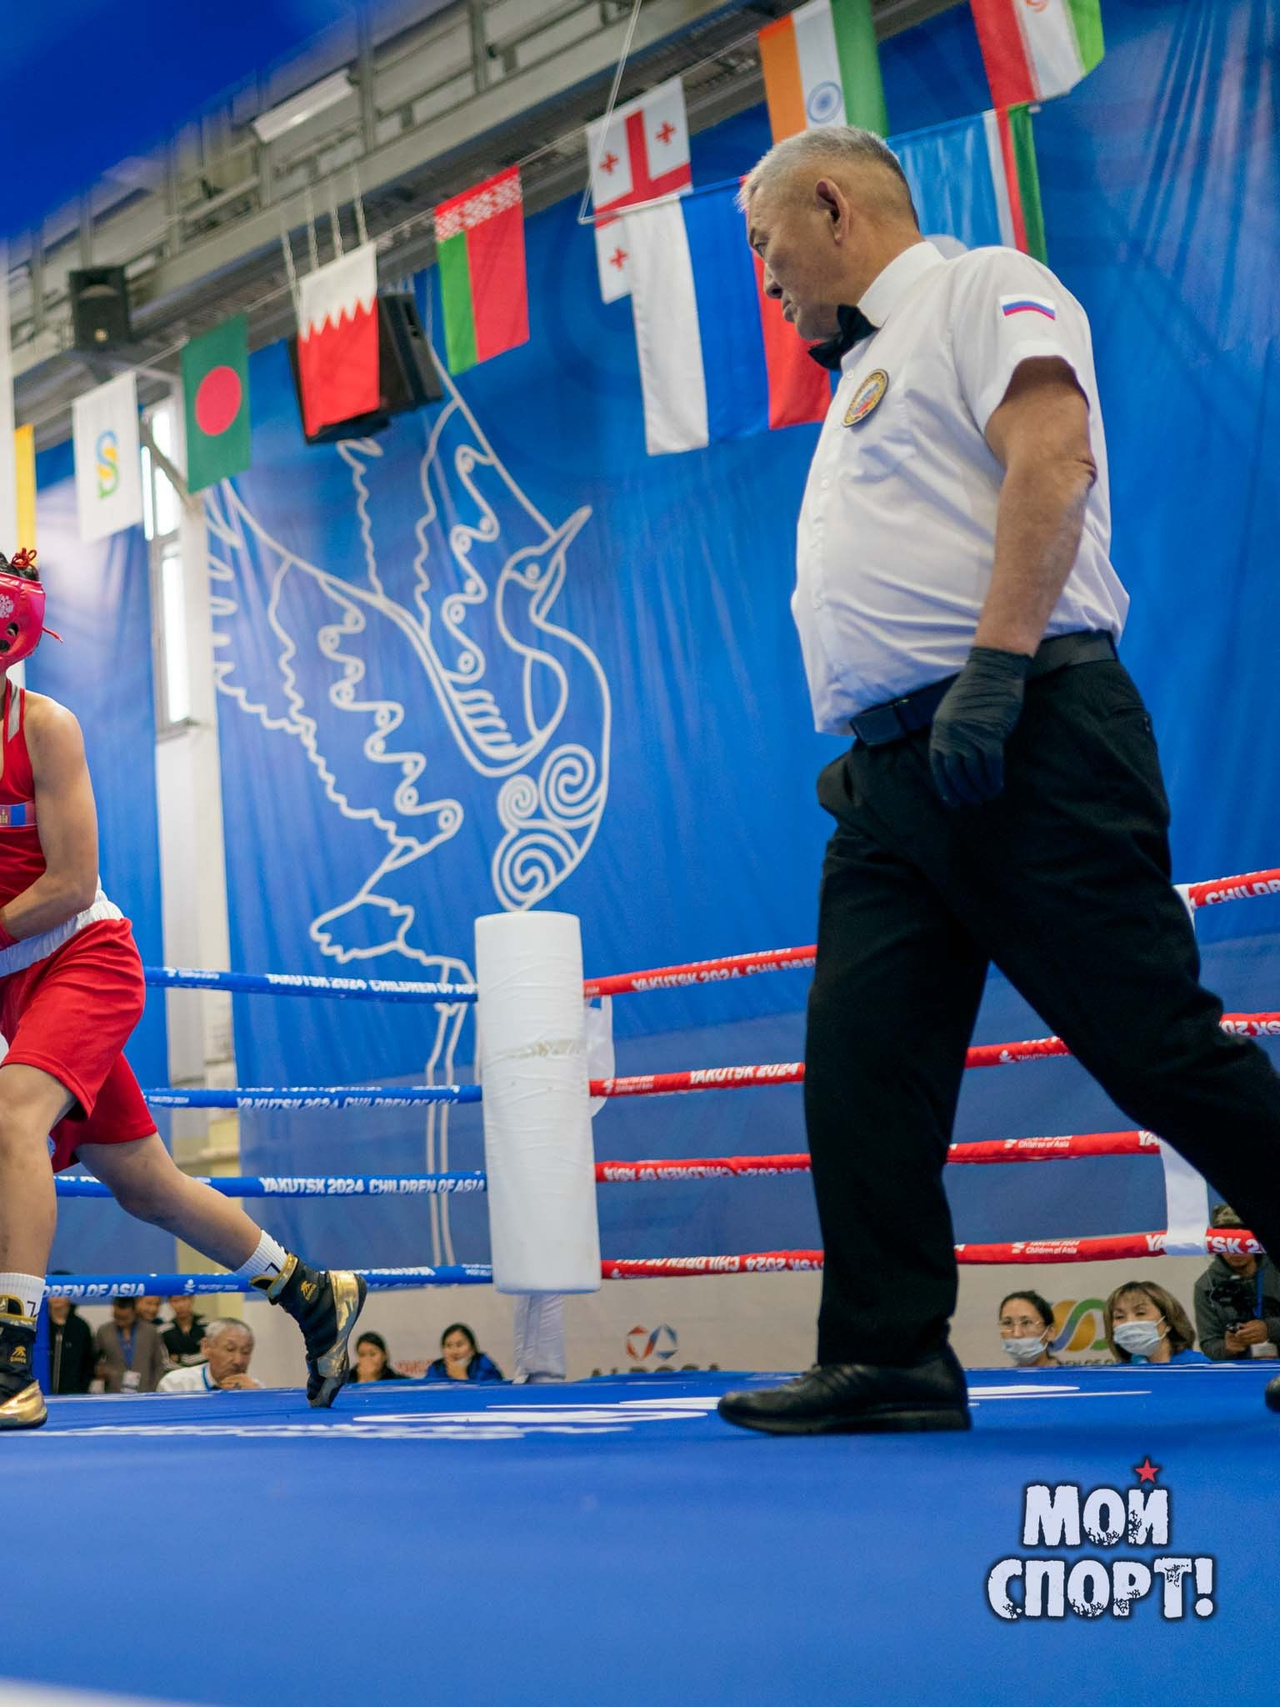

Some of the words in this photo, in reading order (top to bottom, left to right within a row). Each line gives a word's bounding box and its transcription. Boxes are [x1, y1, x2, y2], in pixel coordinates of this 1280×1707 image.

[1205, 878, 1280, 906] CHILDR
[258, 1177, 326, 1195] YAKUTSK
[327, 1177, 365, 1194] 2024
[109, 1282, 146, 1297] ASIA
